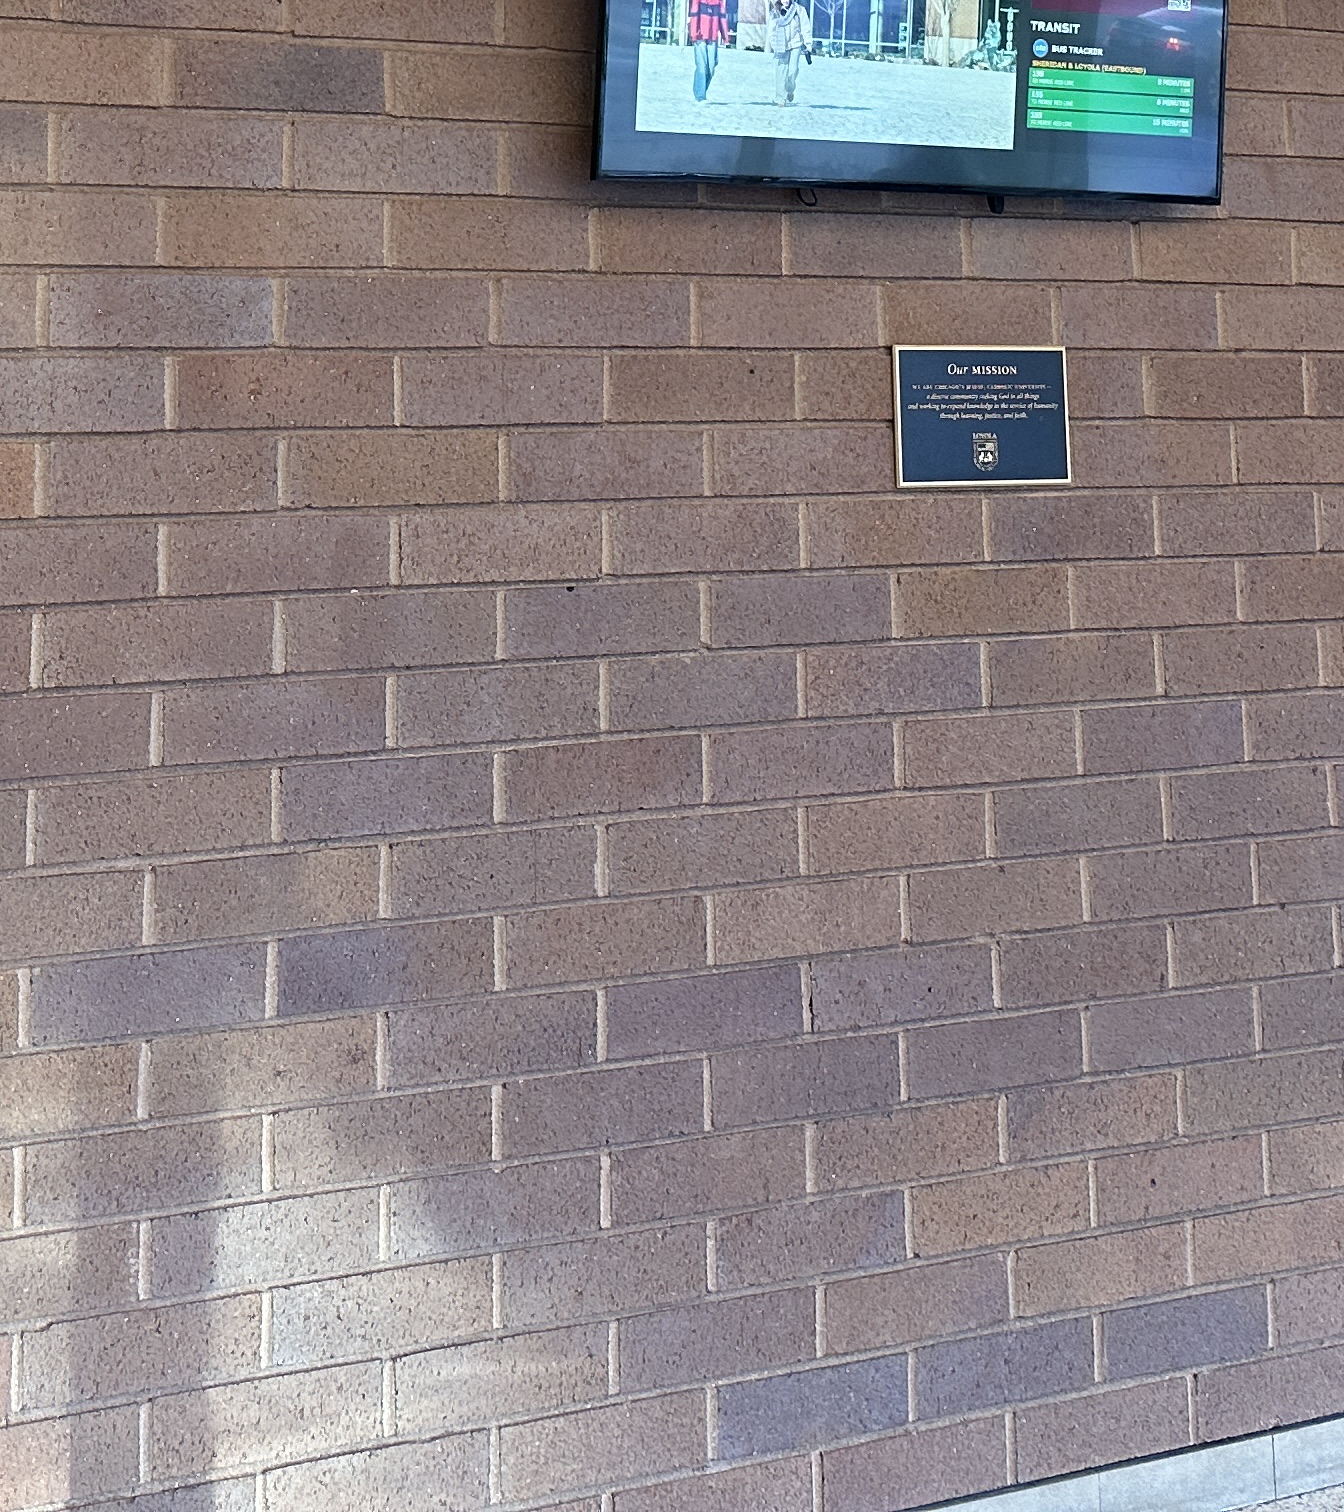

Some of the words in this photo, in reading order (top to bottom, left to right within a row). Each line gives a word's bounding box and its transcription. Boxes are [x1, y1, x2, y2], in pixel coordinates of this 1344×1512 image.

[1030, 20, 1081, 34] TRANSIT
[1052, 44, 1068, 54] BUS
[1069, 45, 1104, 57] TRACKER
[1075, 62, 1101, 72] LOYOLA
[947, 363, 969, 375] Our
[971, 365, 1017, 375] MISSION
